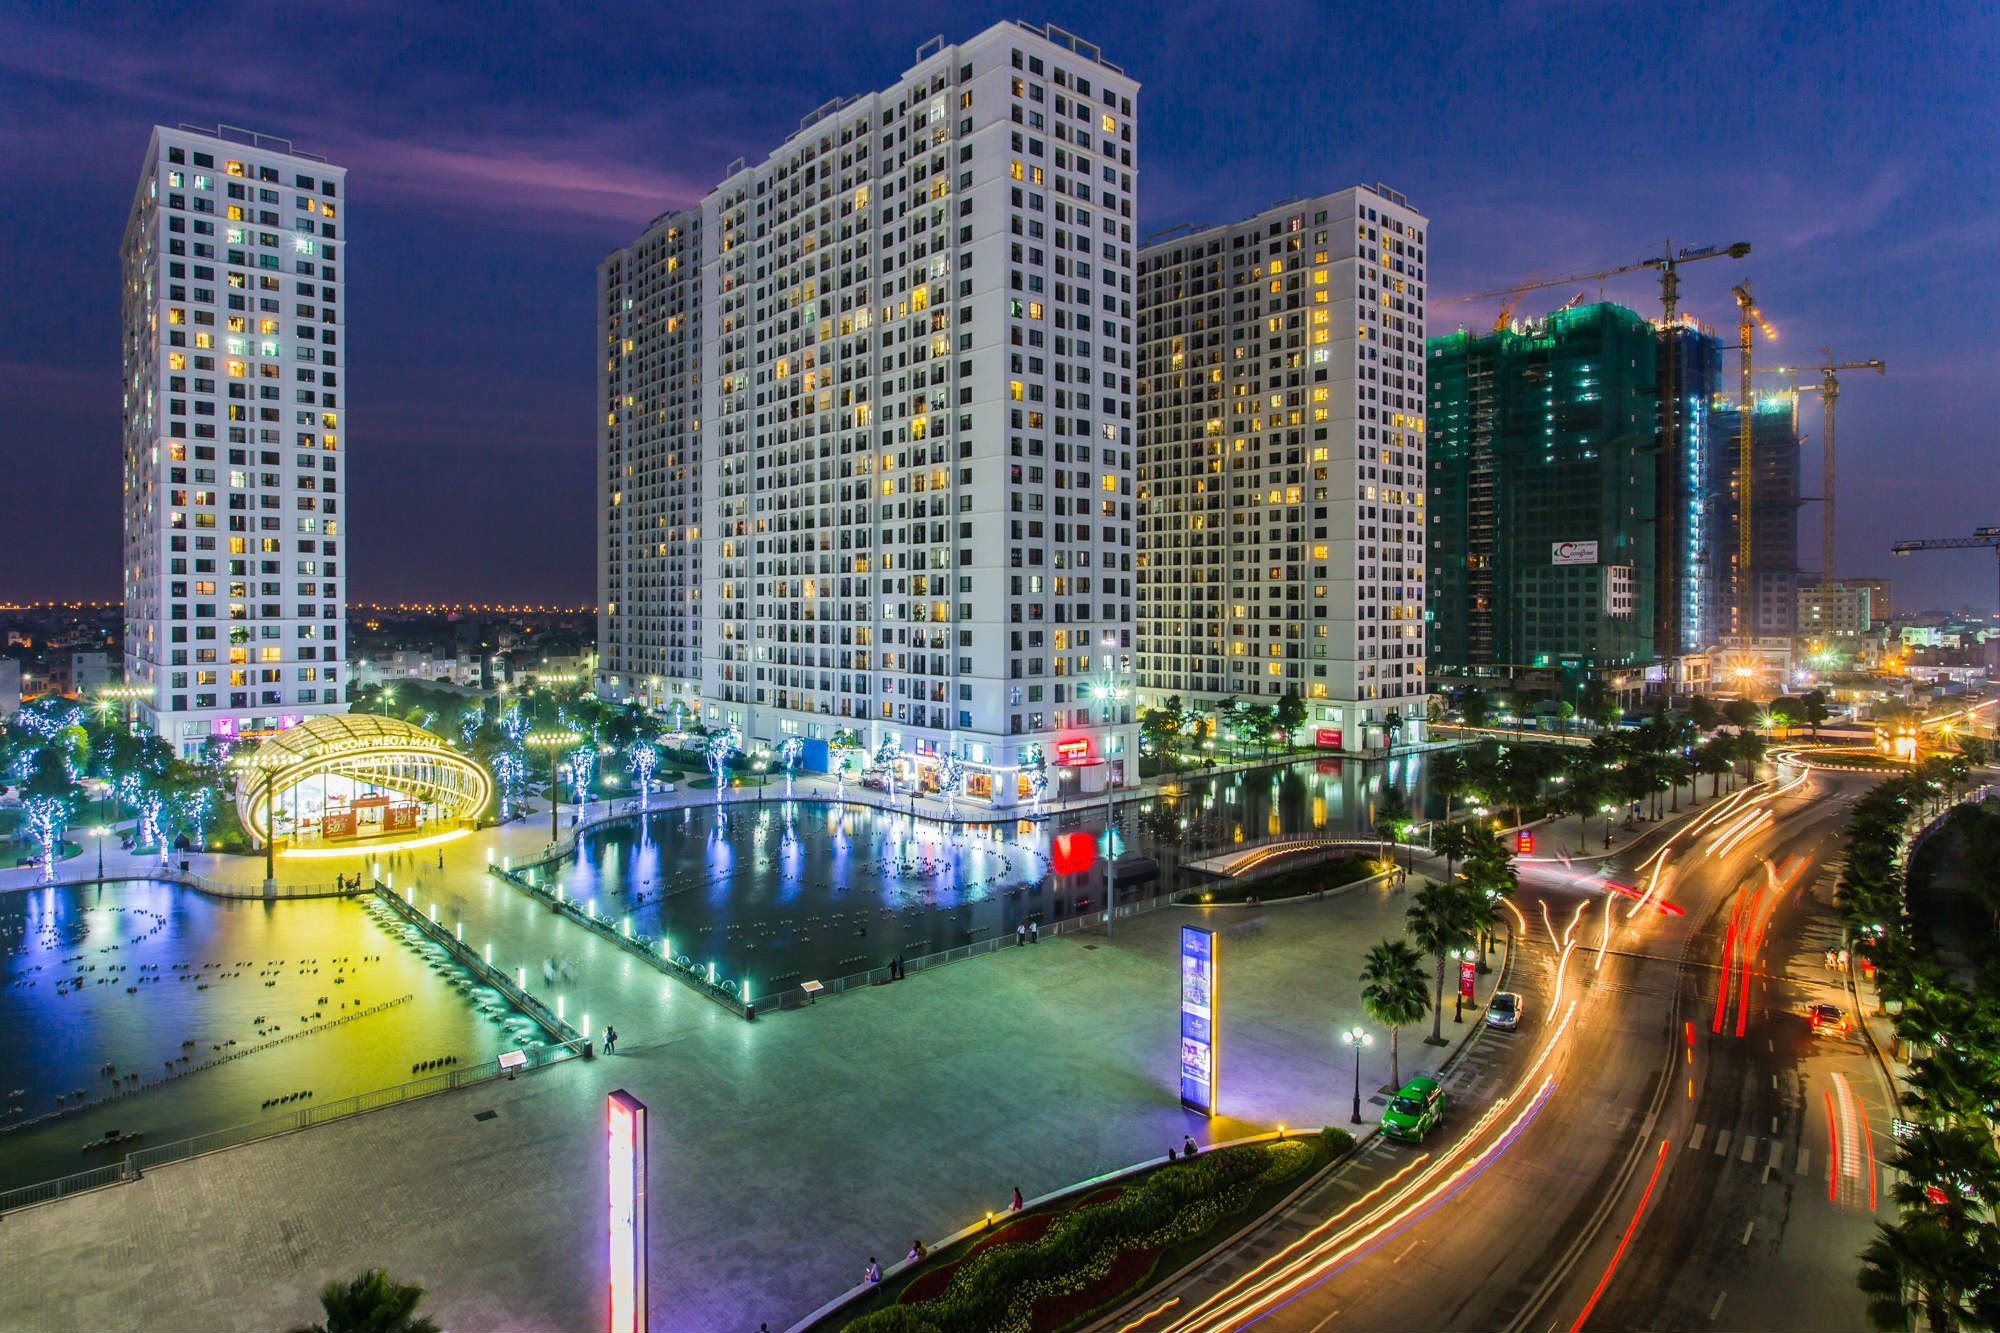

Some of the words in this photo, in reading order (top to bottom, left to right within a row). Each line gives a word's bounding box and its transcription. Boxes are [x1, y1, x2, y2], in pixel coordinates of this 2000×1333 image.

[315, 739, 369, 755] VINCOM
[372, 736, 407, 747] MEGA
[409, 737, 441, 749] MALL
